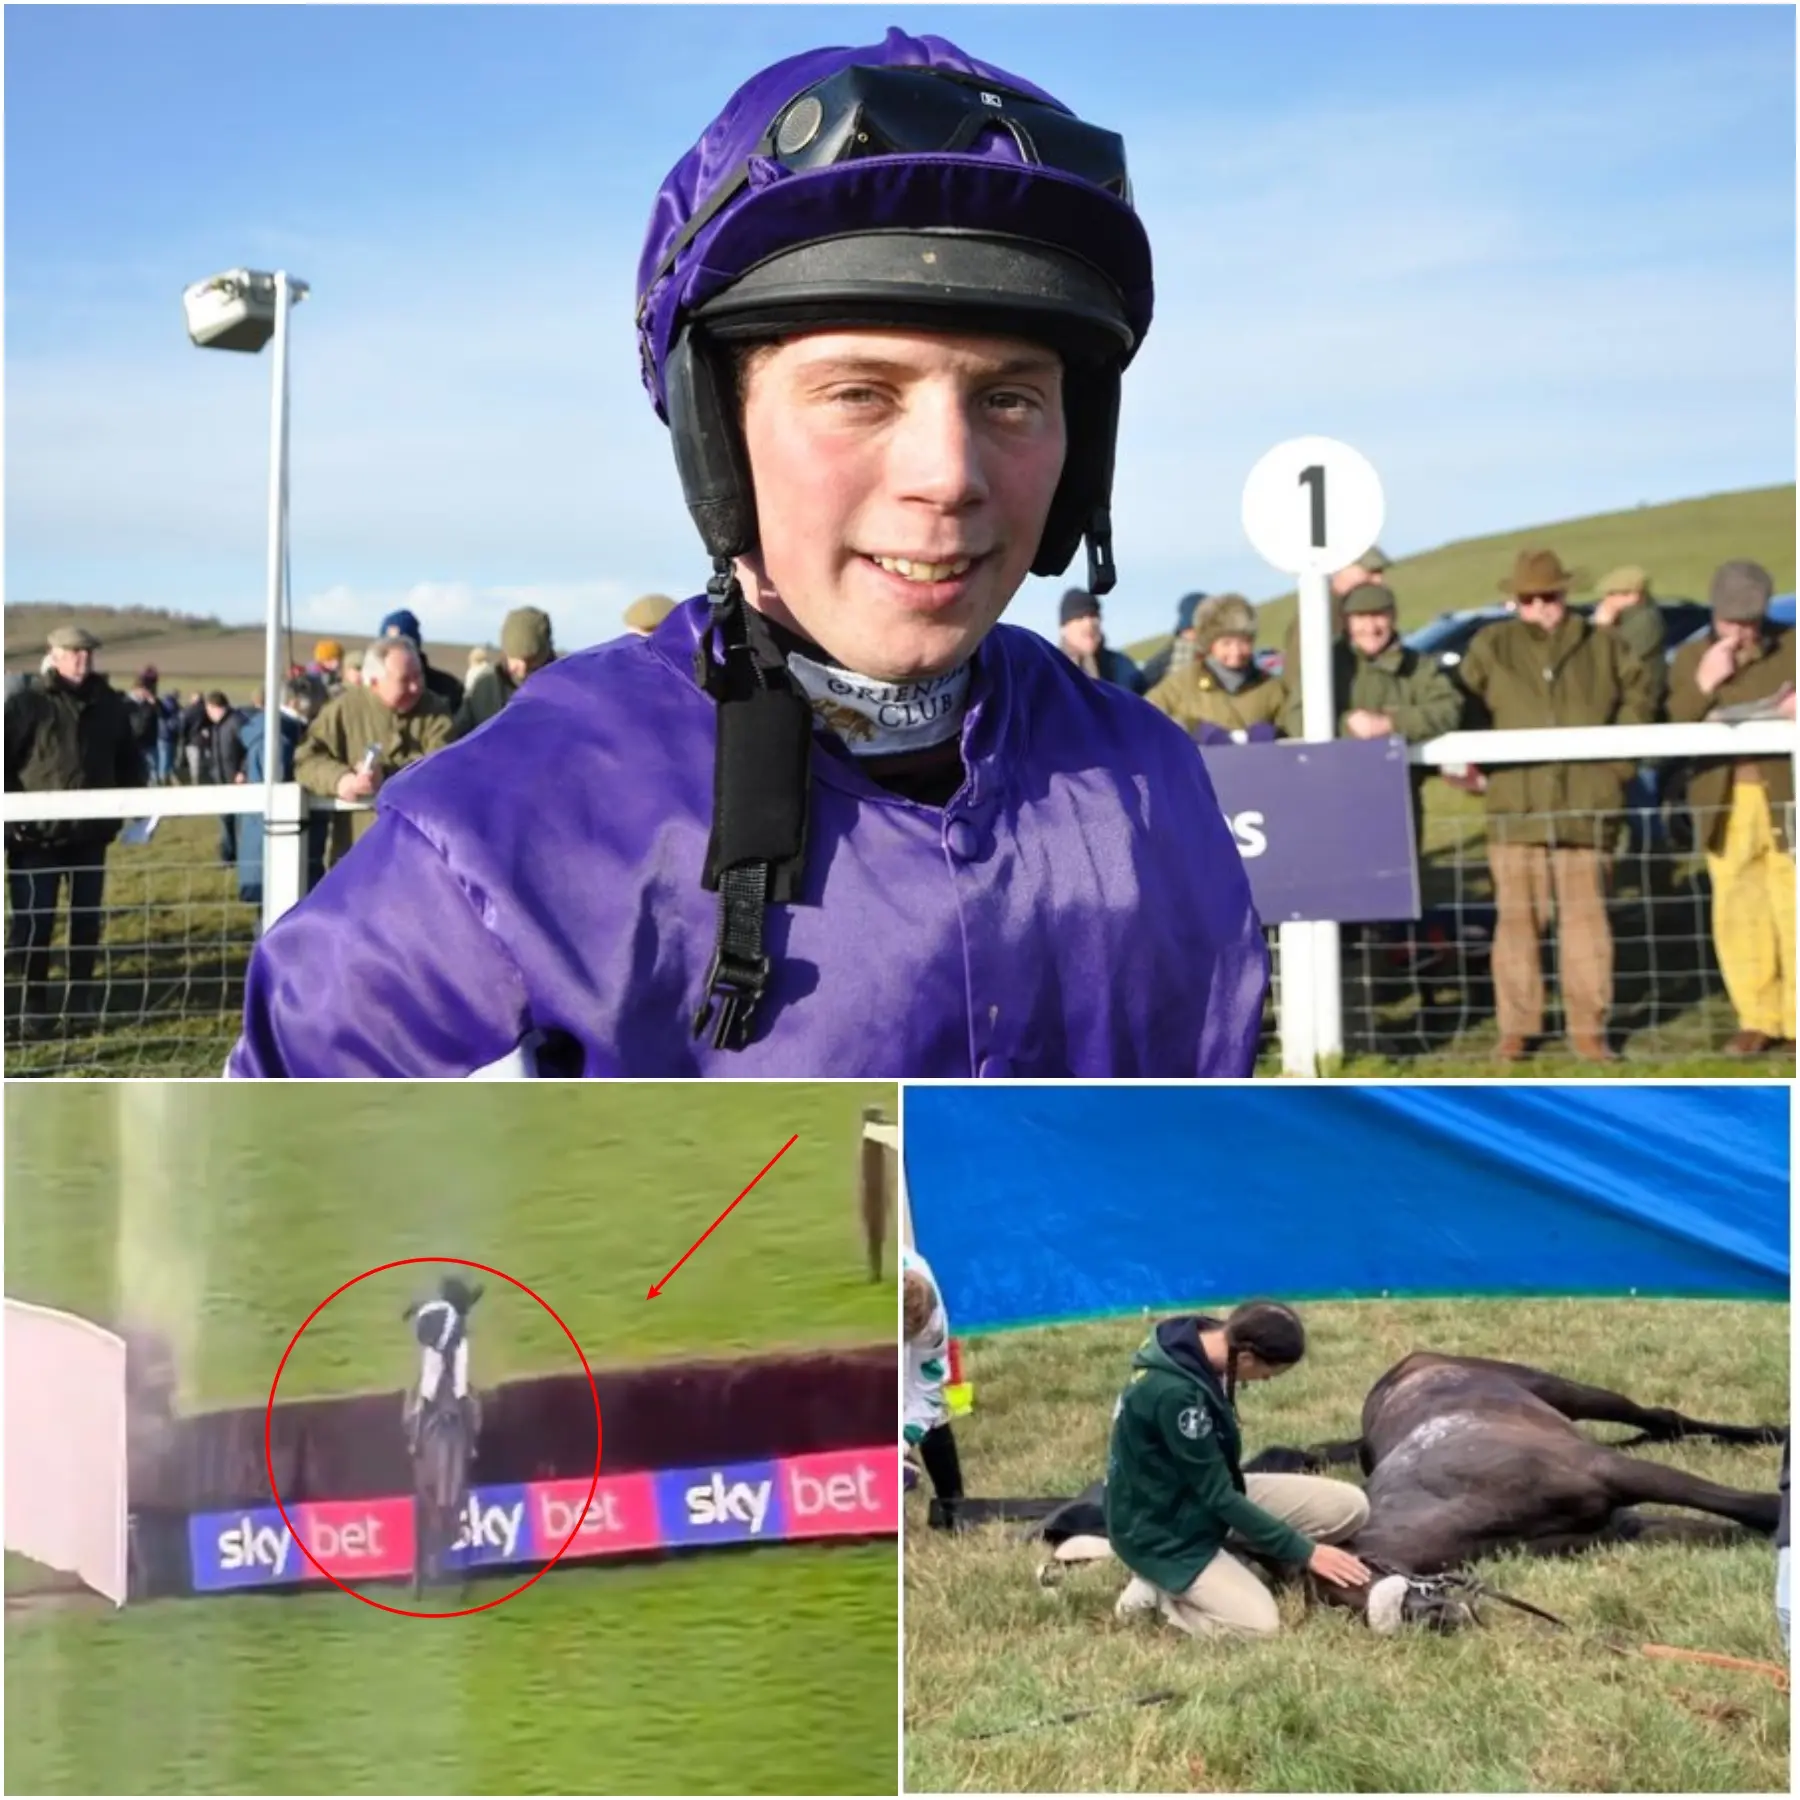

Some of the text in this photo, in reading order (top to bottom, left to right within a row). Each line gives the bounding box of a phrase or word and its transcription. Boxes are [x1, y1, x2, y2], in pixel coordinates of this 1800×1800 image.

[1297, 465, 1327, 548] 1
[827, 668, 964, 704] ORIEN
[878, 693, 953, 728] CLUB
[1223, 810, 1268, 858] s
[541, 1492, 624, 1538] bet
[685, 1464, 882, 1533] sky bet
[217, 1514, 384, 1576] sky bet
